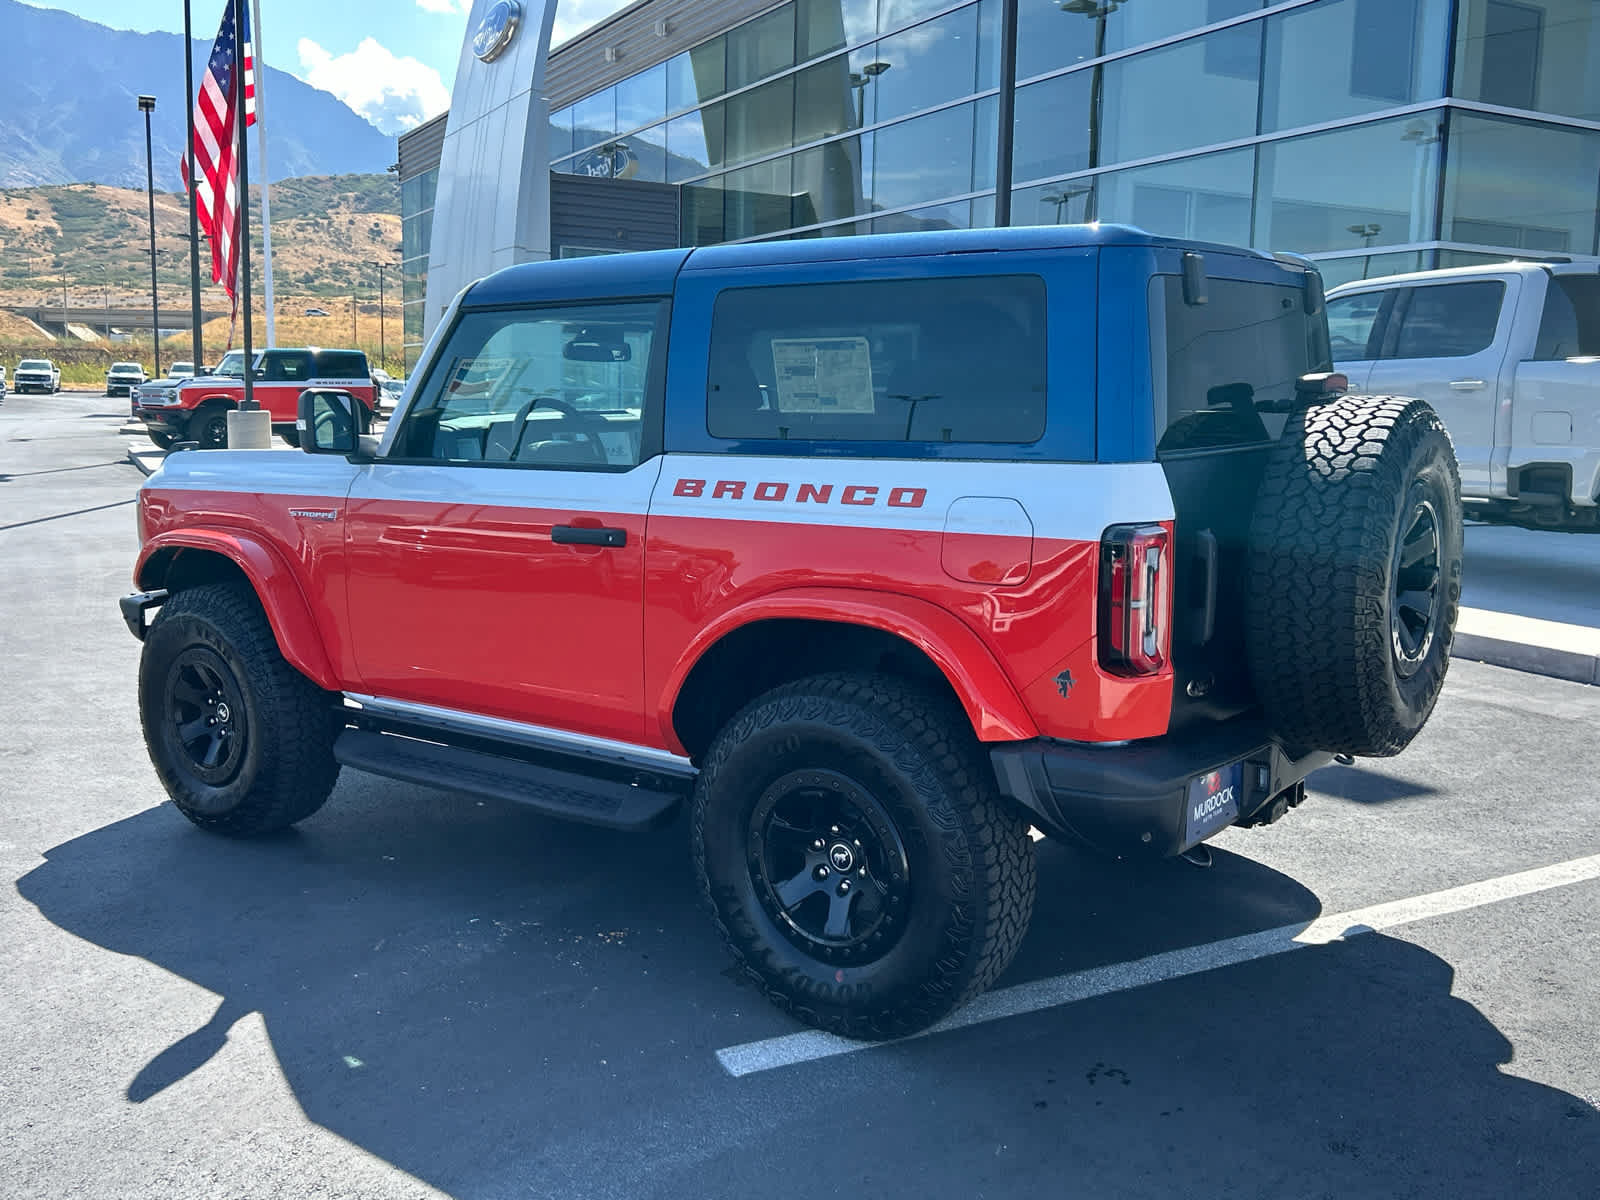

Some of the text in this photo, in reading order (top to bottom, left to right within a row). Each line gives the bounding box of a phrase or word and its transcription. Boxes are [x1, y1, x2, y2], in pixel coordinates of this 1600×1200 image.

[673, 478, 927, 508] BRONCO
[288, 510, 336, 520] STROPPE
[1194, 786, 1233, 822] MURDOCK
